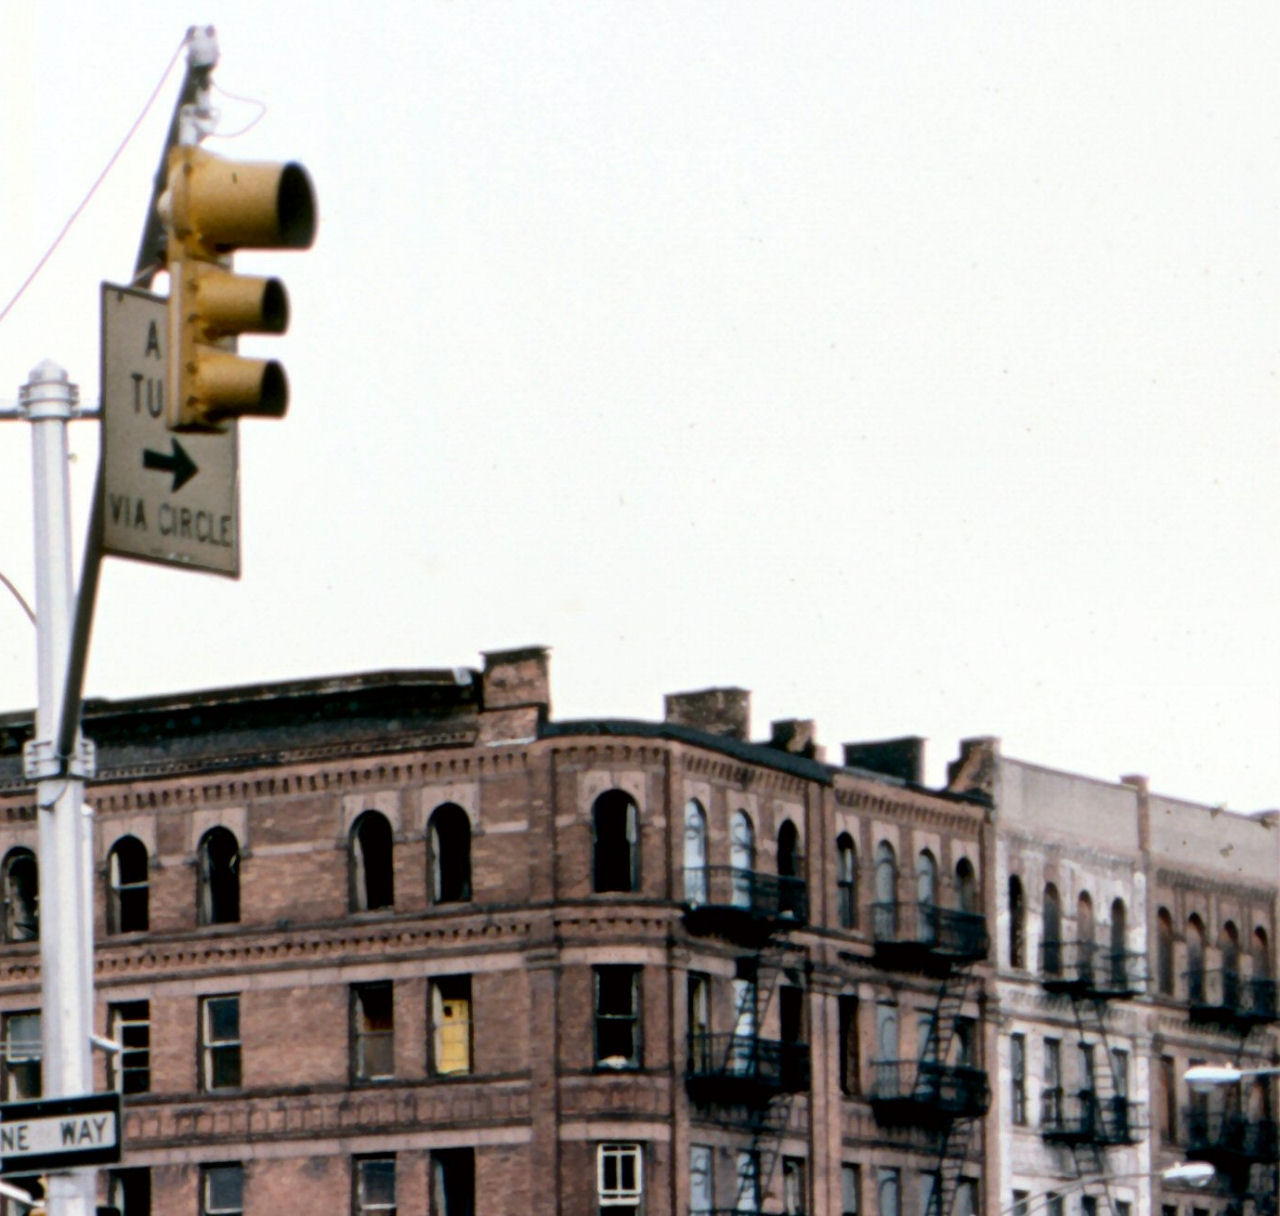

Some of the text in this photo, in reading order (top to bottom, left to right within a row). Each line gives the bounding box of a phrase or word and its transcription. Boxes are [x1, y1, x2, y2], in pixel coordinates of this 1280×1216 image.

[109, 493, 233, 548] VIA CIRCLE
[60, 1116, 107, 1147] WAY
